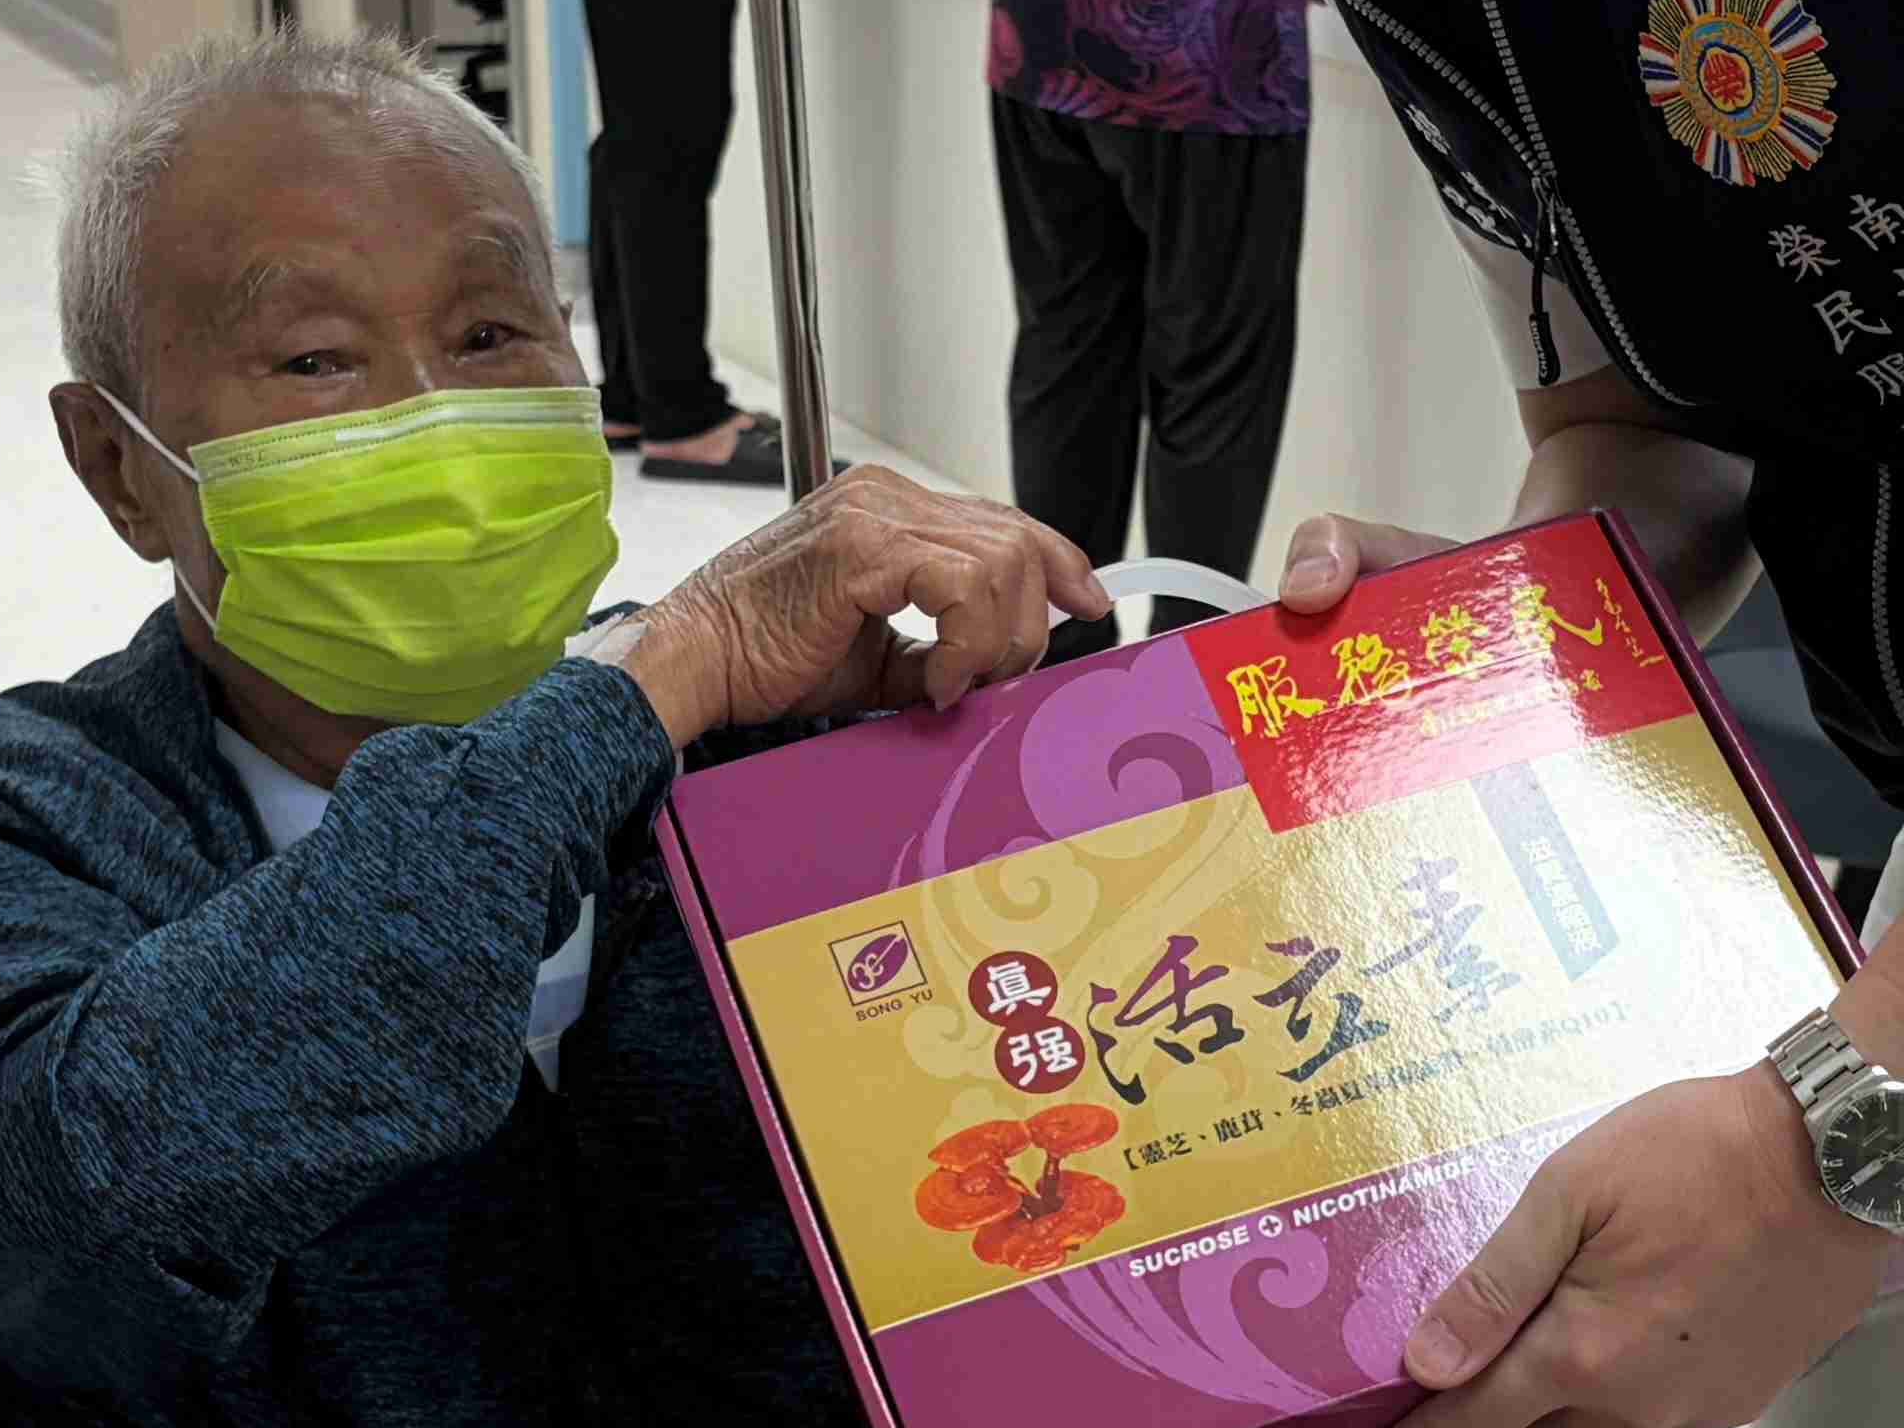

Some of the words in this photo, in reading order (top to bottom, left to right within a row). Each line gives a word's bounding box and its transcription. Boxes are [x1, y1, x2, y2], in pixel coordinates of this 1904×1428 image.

[909, 988, 934, 1004] YU
[1128, 1224, 1251, 1278] SUCROSE
[1291, 1154, 1478, 1229] NICOTINAMIDE
